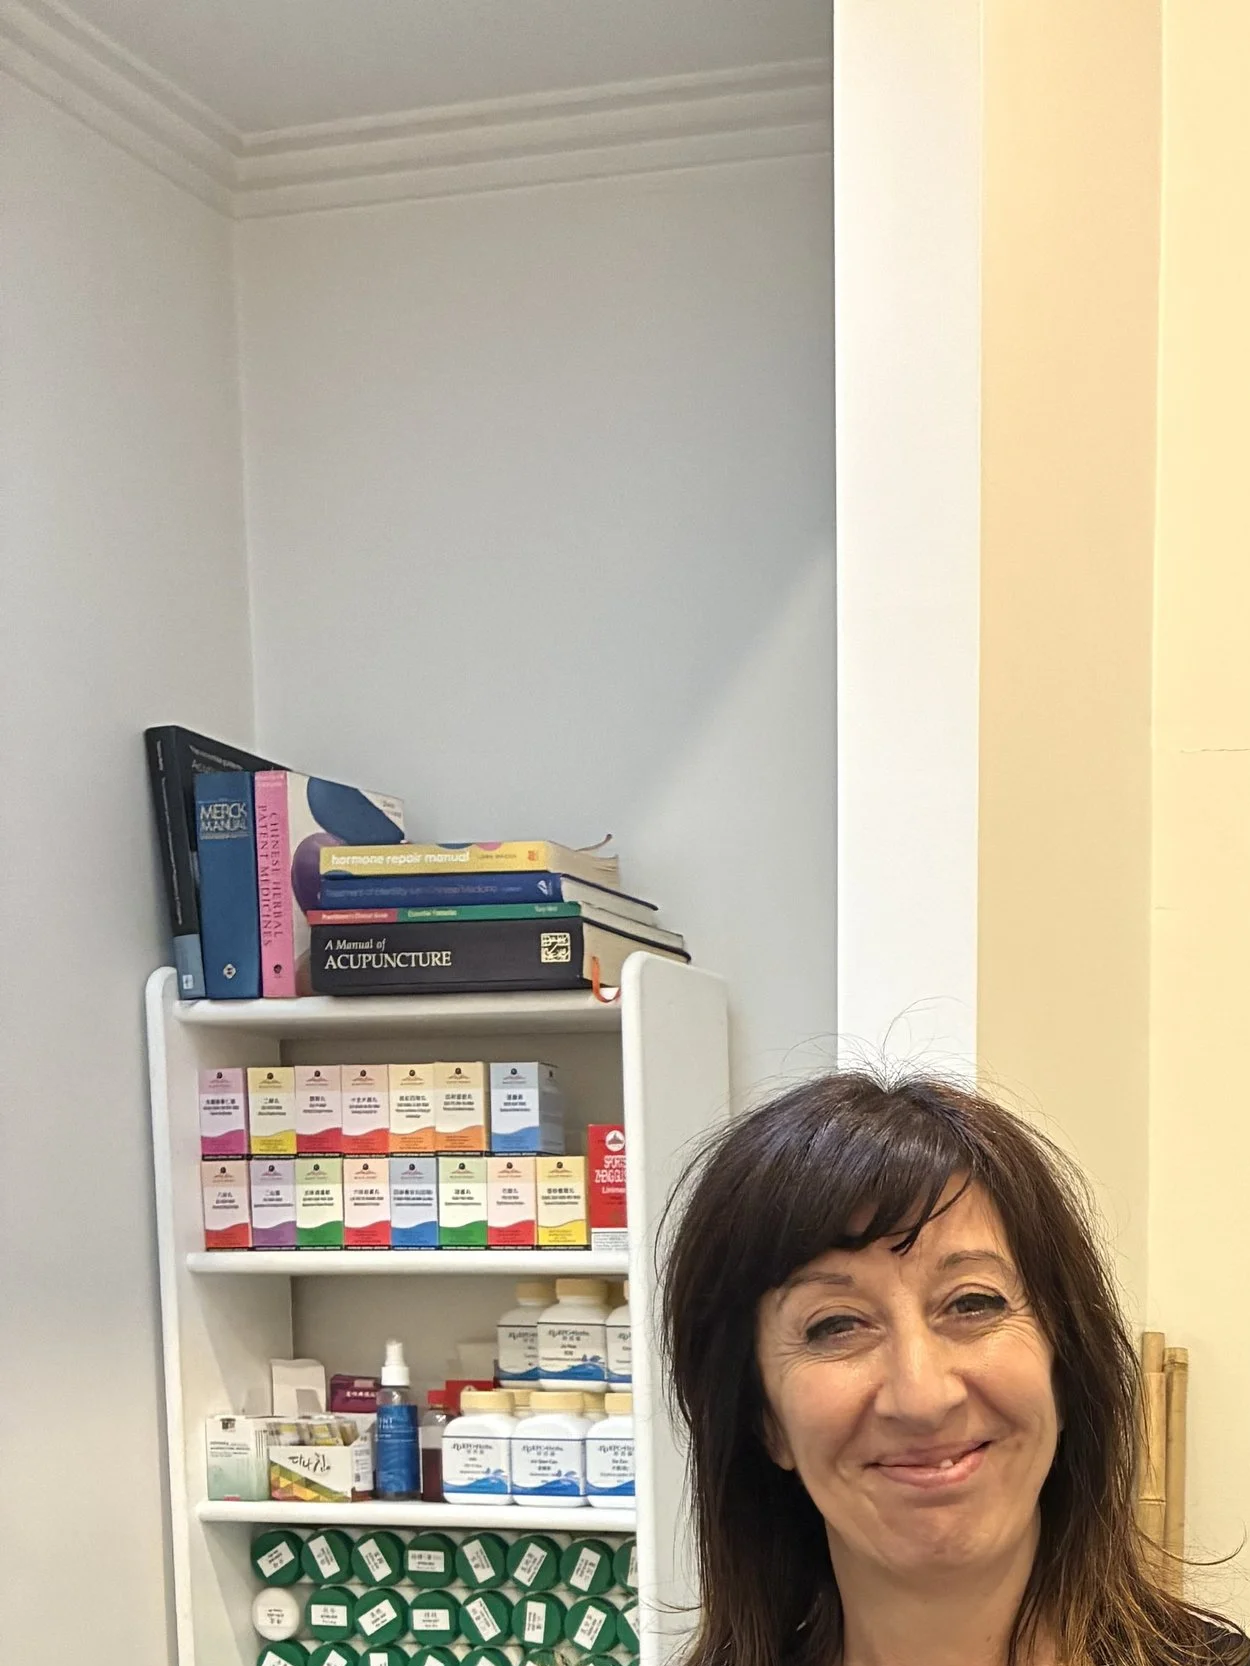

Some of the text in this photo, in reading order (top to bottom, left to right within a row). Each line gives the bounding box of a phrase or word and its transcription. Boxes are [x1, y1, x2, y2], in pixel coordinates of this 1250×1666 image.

[200, 802, 247, 820] MERCK
[201, 818, 247, 832] MANUAL
[331, 855, 383, 865] hormone
[386, 852, 421, 865] repair
[424, 850, 470, 863] manual
[257, 804, 273, 947] PATENT MEDICINES
[269, 811, 284, 938] CHINESE HERBAL
[324, 938, 387, 951] A Manual of
[324, 951, 453, 970] ACUPUNCTURE
